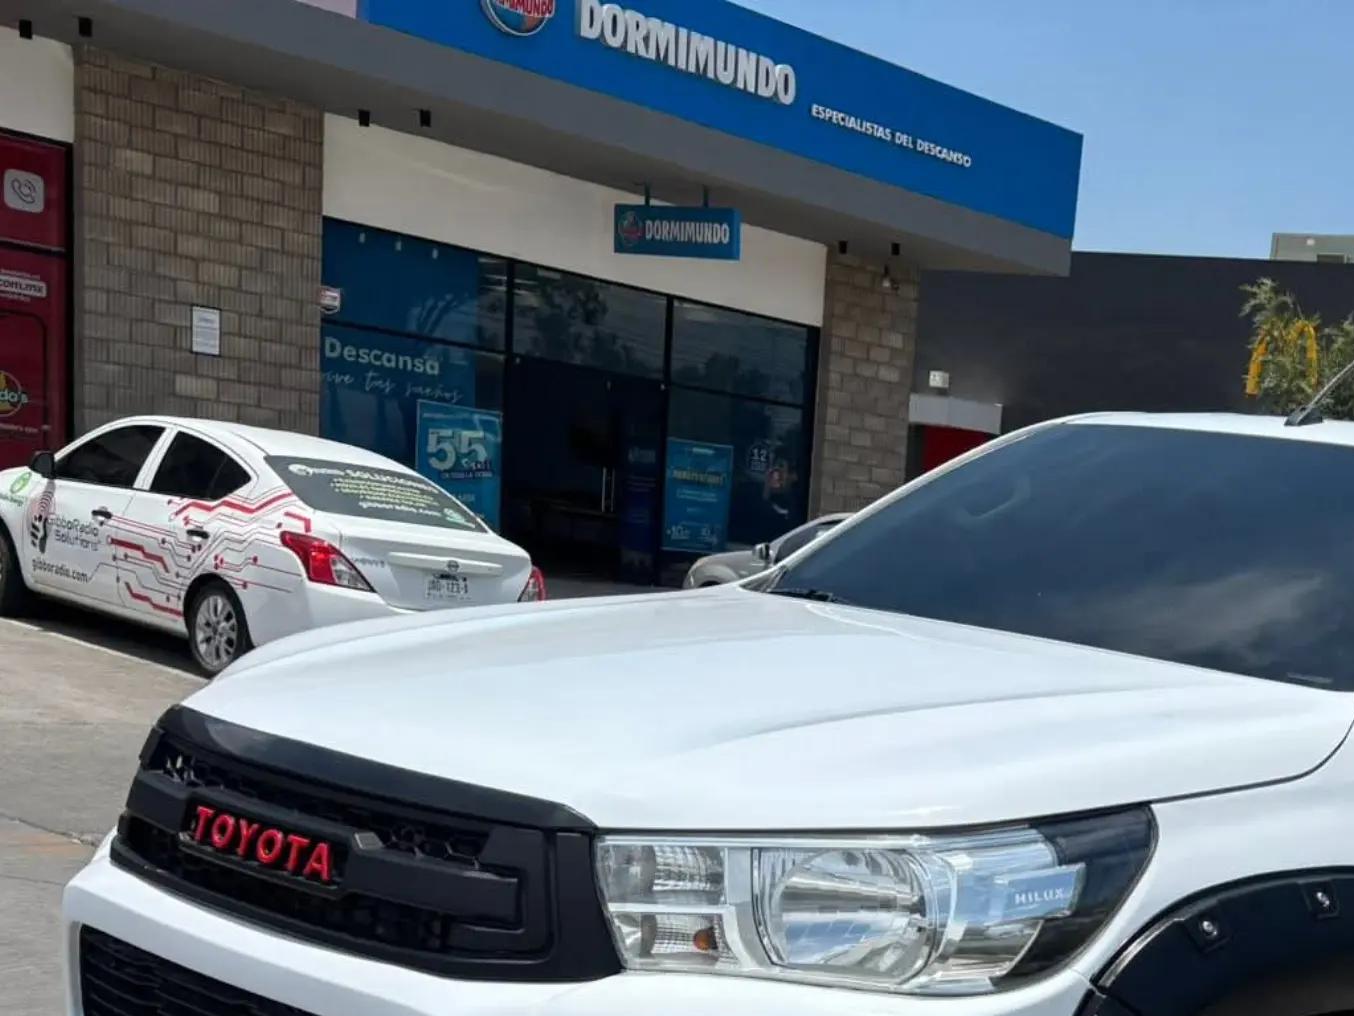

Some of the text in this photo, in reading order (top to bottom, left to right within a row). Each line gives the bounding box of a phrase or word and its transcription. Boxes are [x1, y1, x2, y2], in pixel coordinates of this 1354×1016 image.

[578, 0, 797, 105] DORMIMUNDO
[811, 104, 972, 167] ESPECIALISTAS DEL DESCANSO
[645, 220, 730, 244] DORMIMUNDO
[325, 336, 440, 375] Descansa
[427, 428, 488, 472] 55
[194, 805, 331, 882] TOYOTA
[1015, 887, 1065, 905] HILUX
